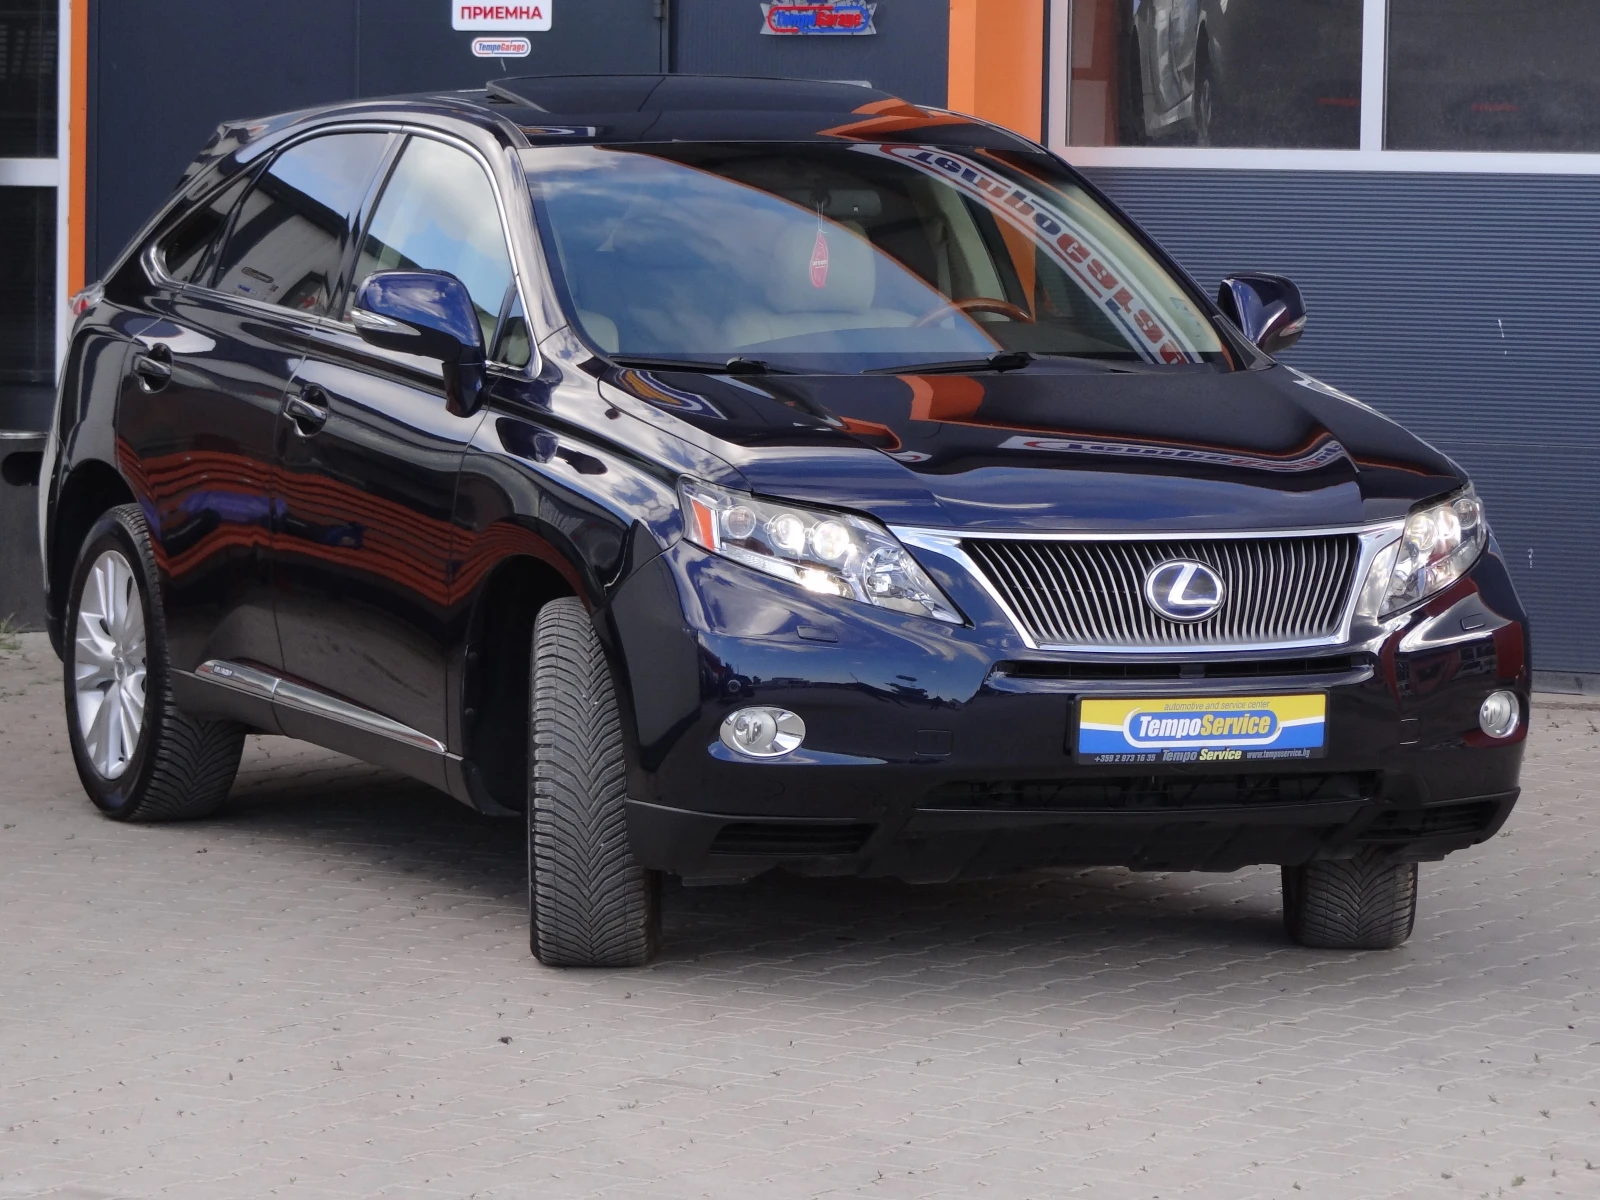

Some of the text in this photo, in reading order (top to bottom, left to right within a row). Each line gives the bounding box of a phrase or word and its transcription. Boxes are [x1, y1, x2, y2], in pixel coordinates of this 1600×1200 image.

[460, 6, 543, 20] ПРИЕМНА
[478, 42, 526, 54] TempoGarage
[1164, 699, 1270, 711] automotive and service center
[1139, 713, 1271, 739] TempoService
[1094, 754, 1114, 763] +359
[1162, 747, 1242, 763] Tempo Service
[1246, 747, 1311, 760] www.temposervice.bg
